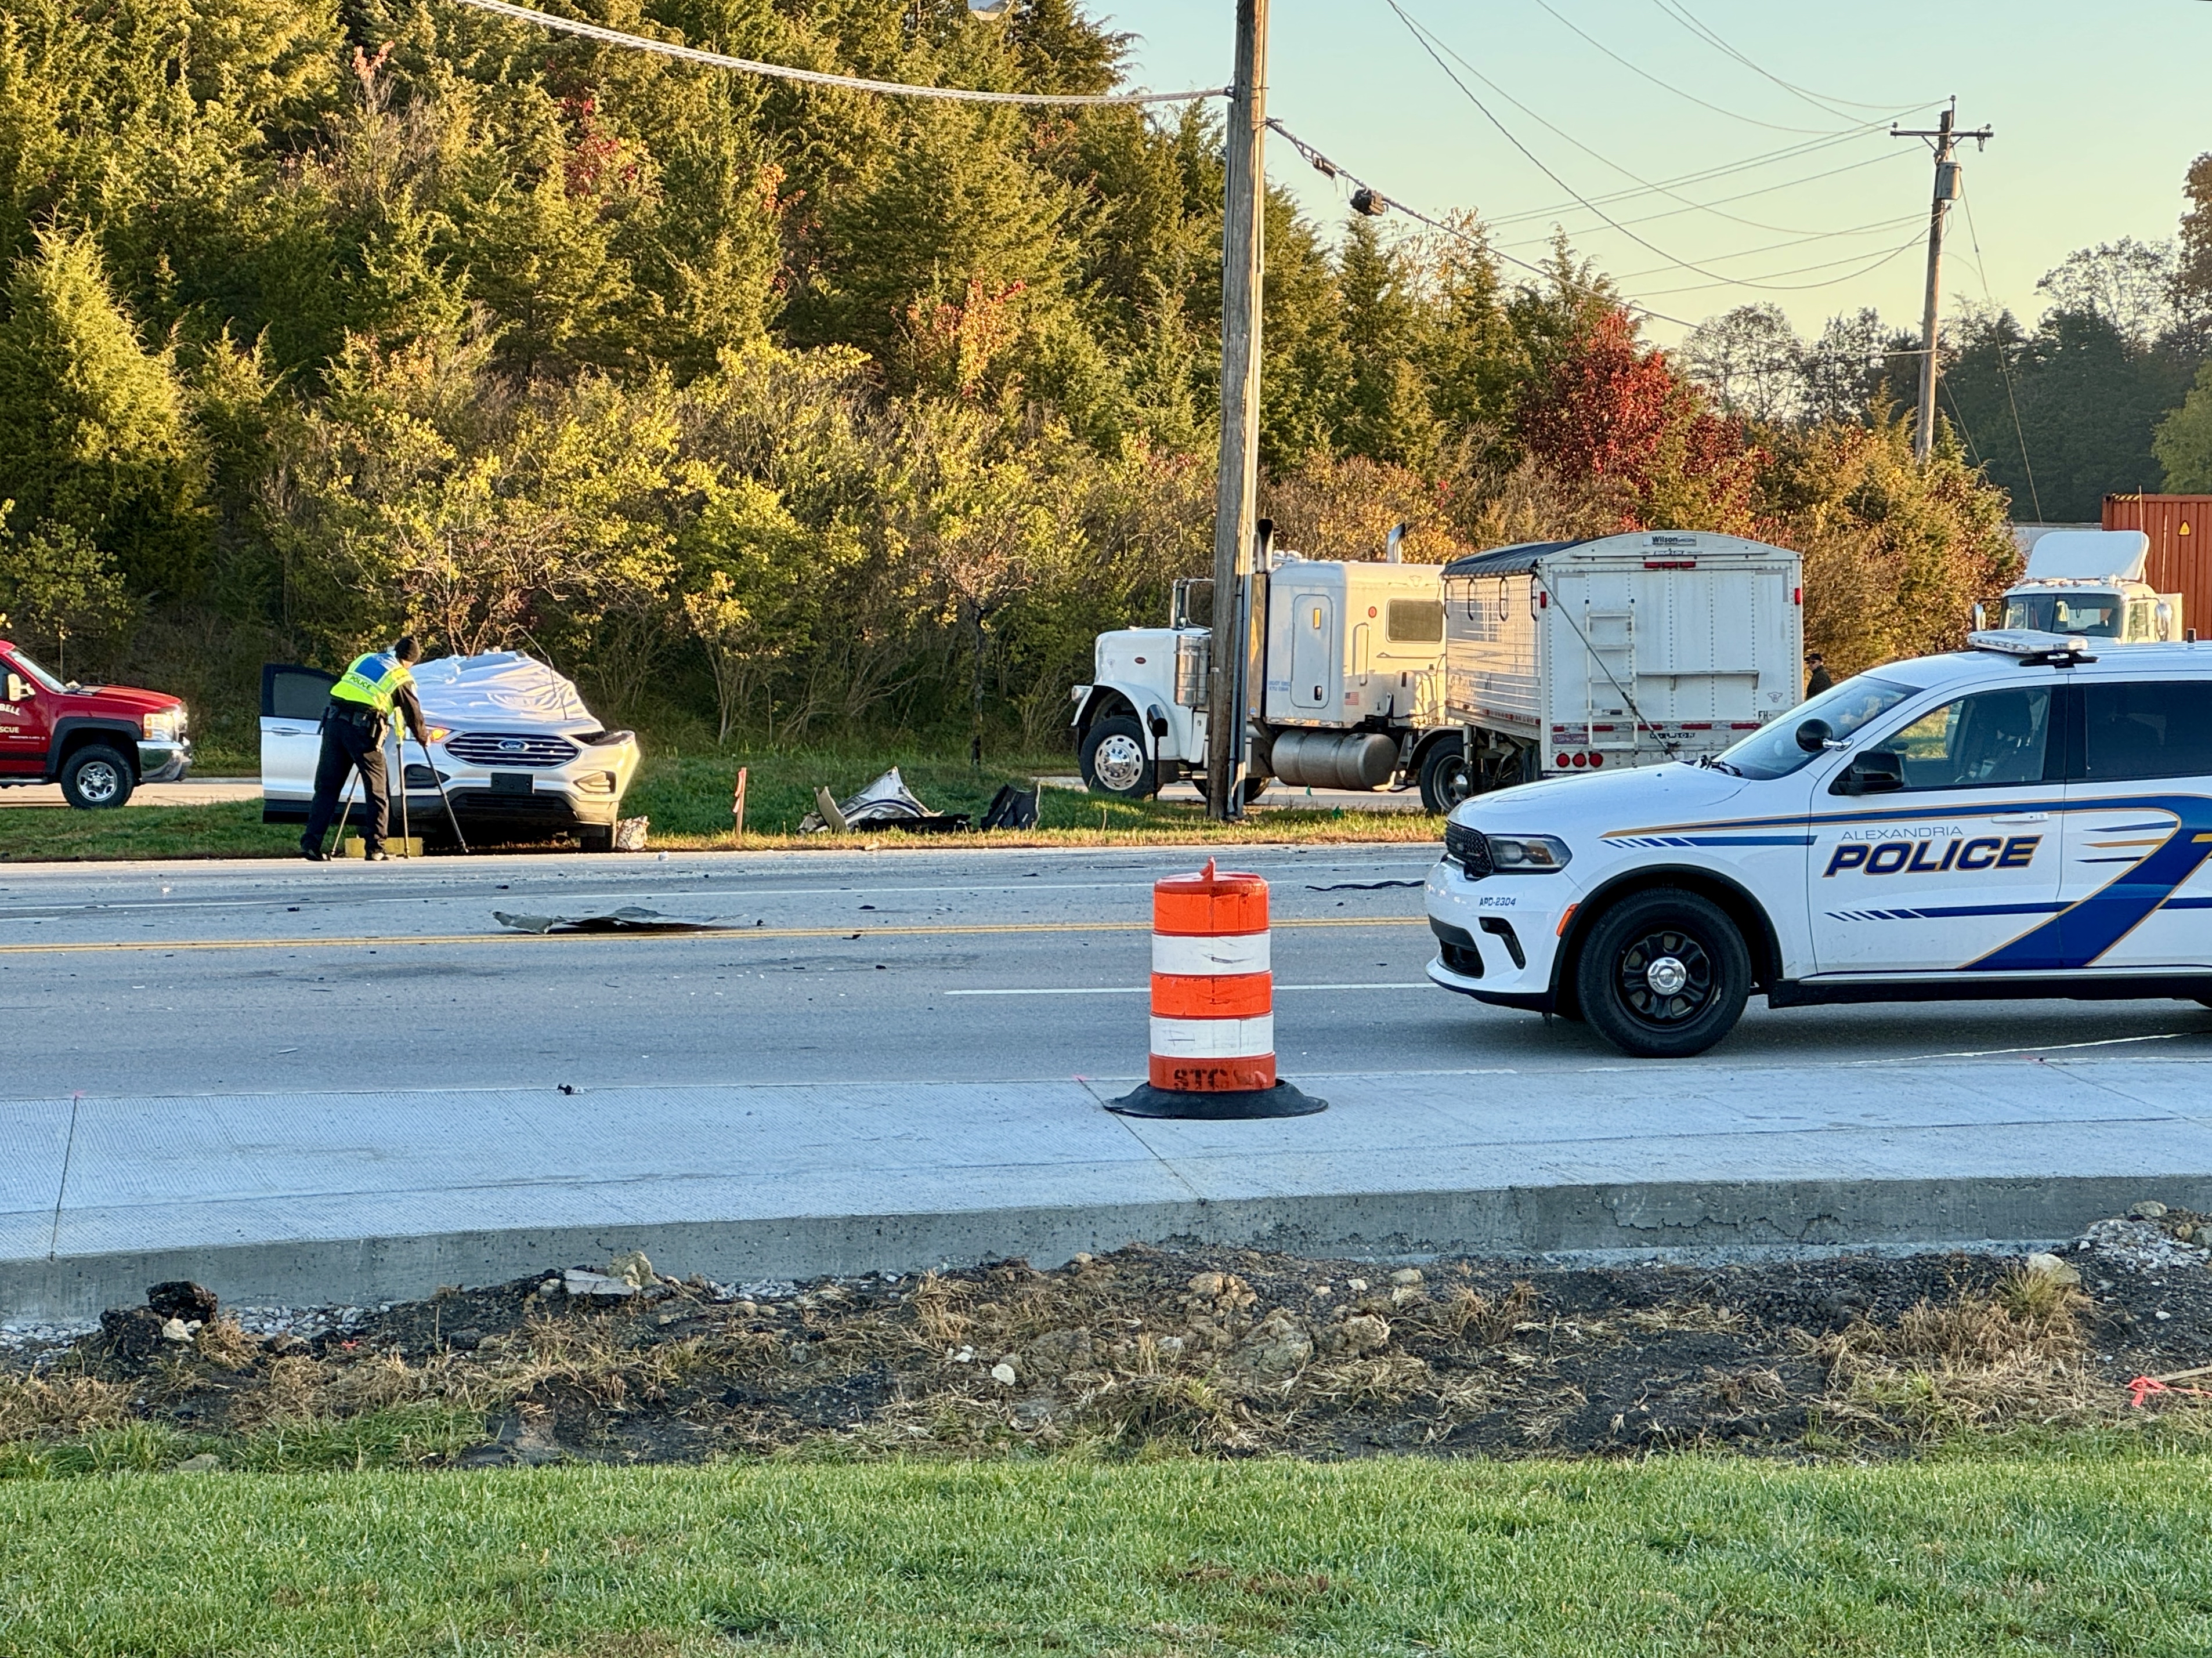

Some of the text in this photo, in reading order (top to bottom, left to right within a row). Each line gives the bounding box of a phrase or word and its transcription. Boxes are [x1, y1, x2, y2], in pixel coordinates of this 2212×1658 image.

[349, 676, 371, 690] POLICE
[1841, 826, 1963, 841] ALEXANDRIA
[1822, 834, 2044, 878] POLICE
[1479, 897, 1516, 906] APD-2304
